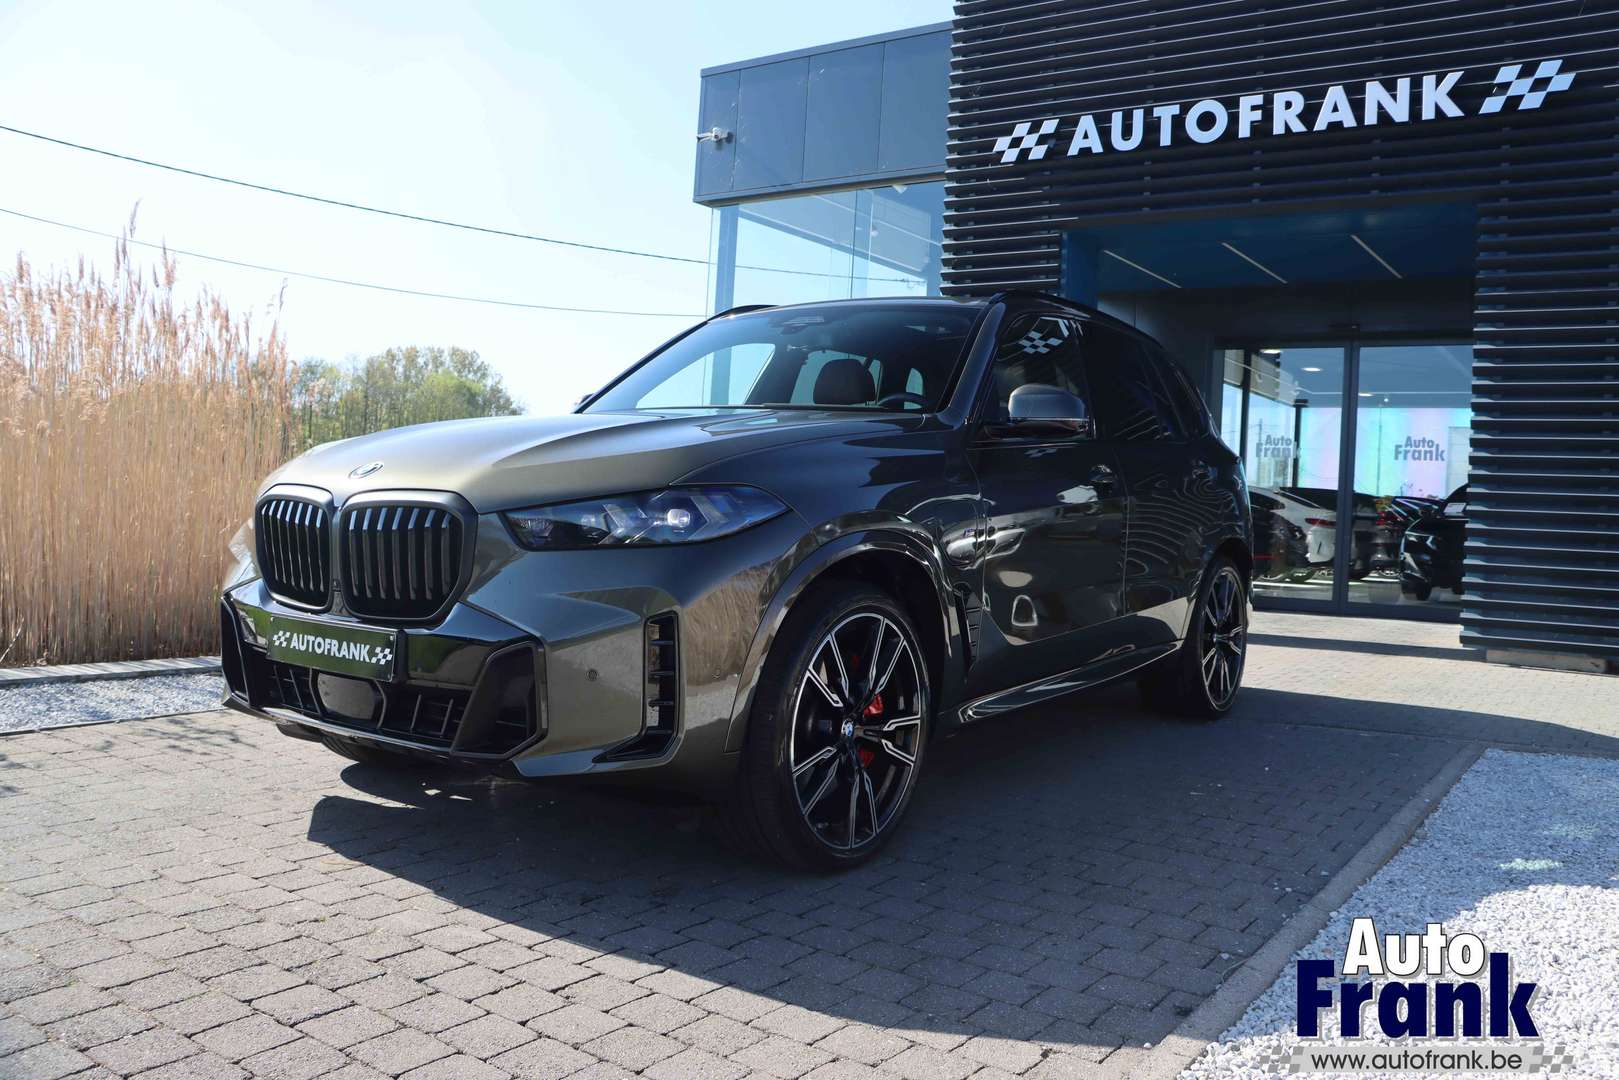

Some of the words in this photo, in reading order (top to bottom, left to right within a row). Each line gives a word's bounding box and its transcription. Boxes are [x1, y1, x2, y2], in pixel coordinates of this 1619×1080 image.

[1067, 70, 1465, 157] AUTOFRANK
[1264, 434, 1292, 447] Auto
[1404, 435, 1434, 449] Auto
[1394, 443, 1445, 461] Frank
[290, 633, 371, 663] AUTOFRANK
